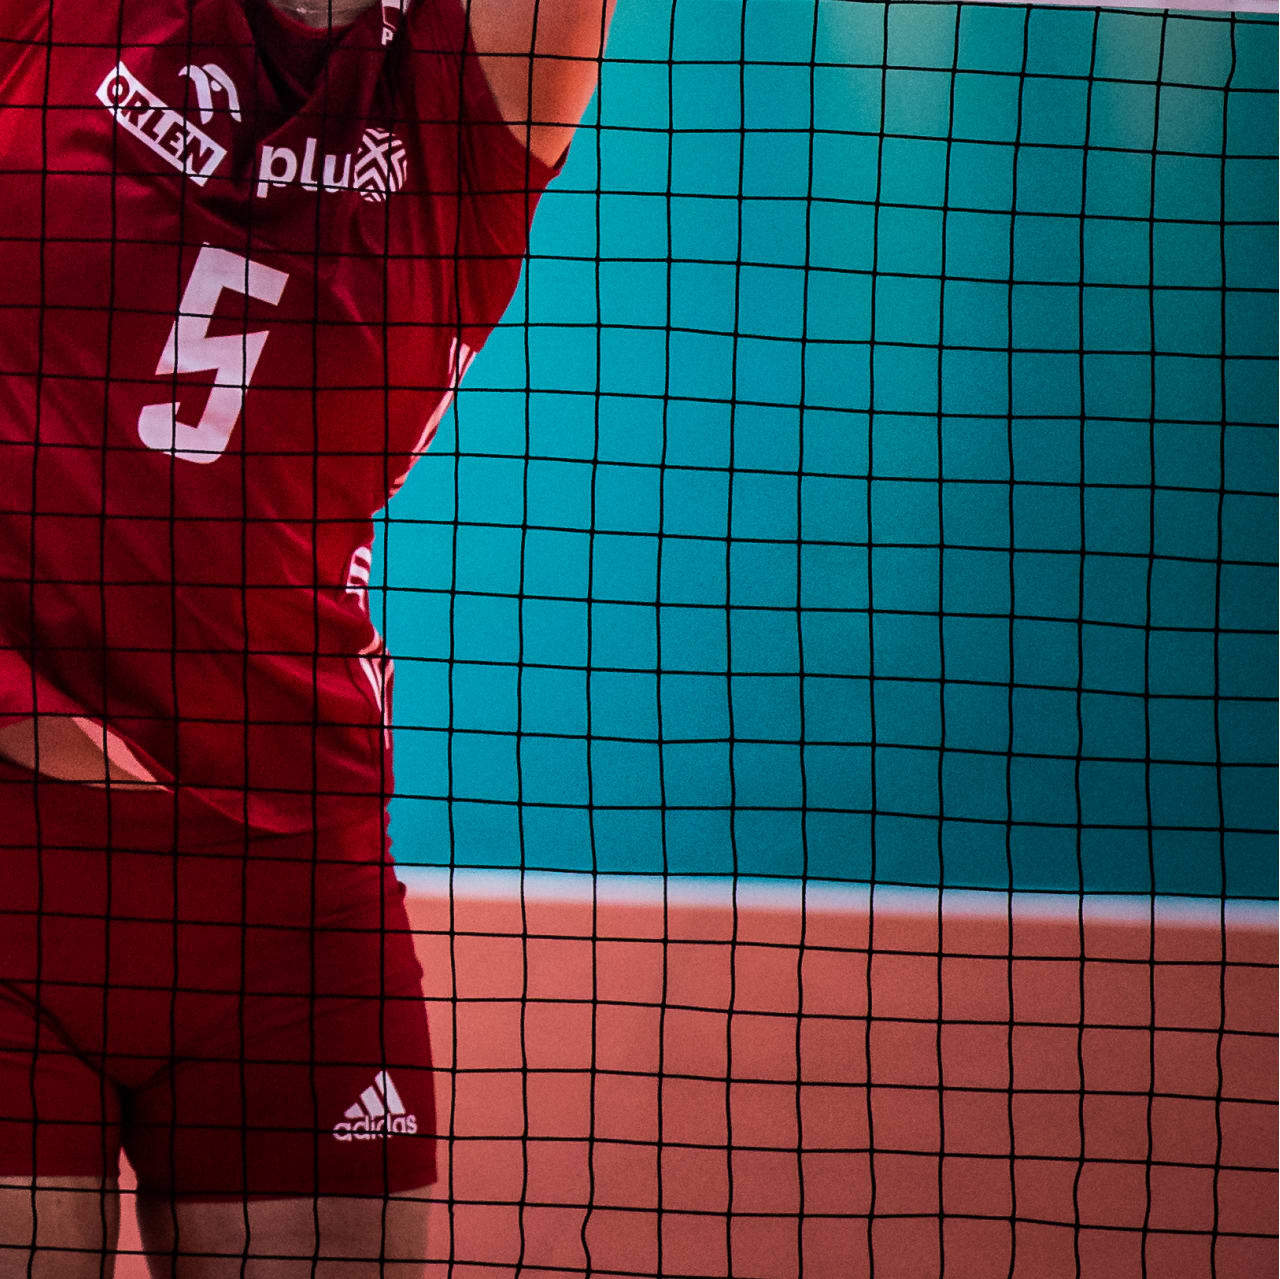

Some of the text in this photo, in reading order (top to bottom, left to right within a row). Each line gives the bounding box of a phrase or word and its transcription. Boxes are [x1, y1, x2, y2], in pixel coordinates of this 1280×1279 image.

[107, 75, 215, 177] ORLEN
[137, 243, 290, 465] 5
[332, 1111, 418, 1141] adidas
